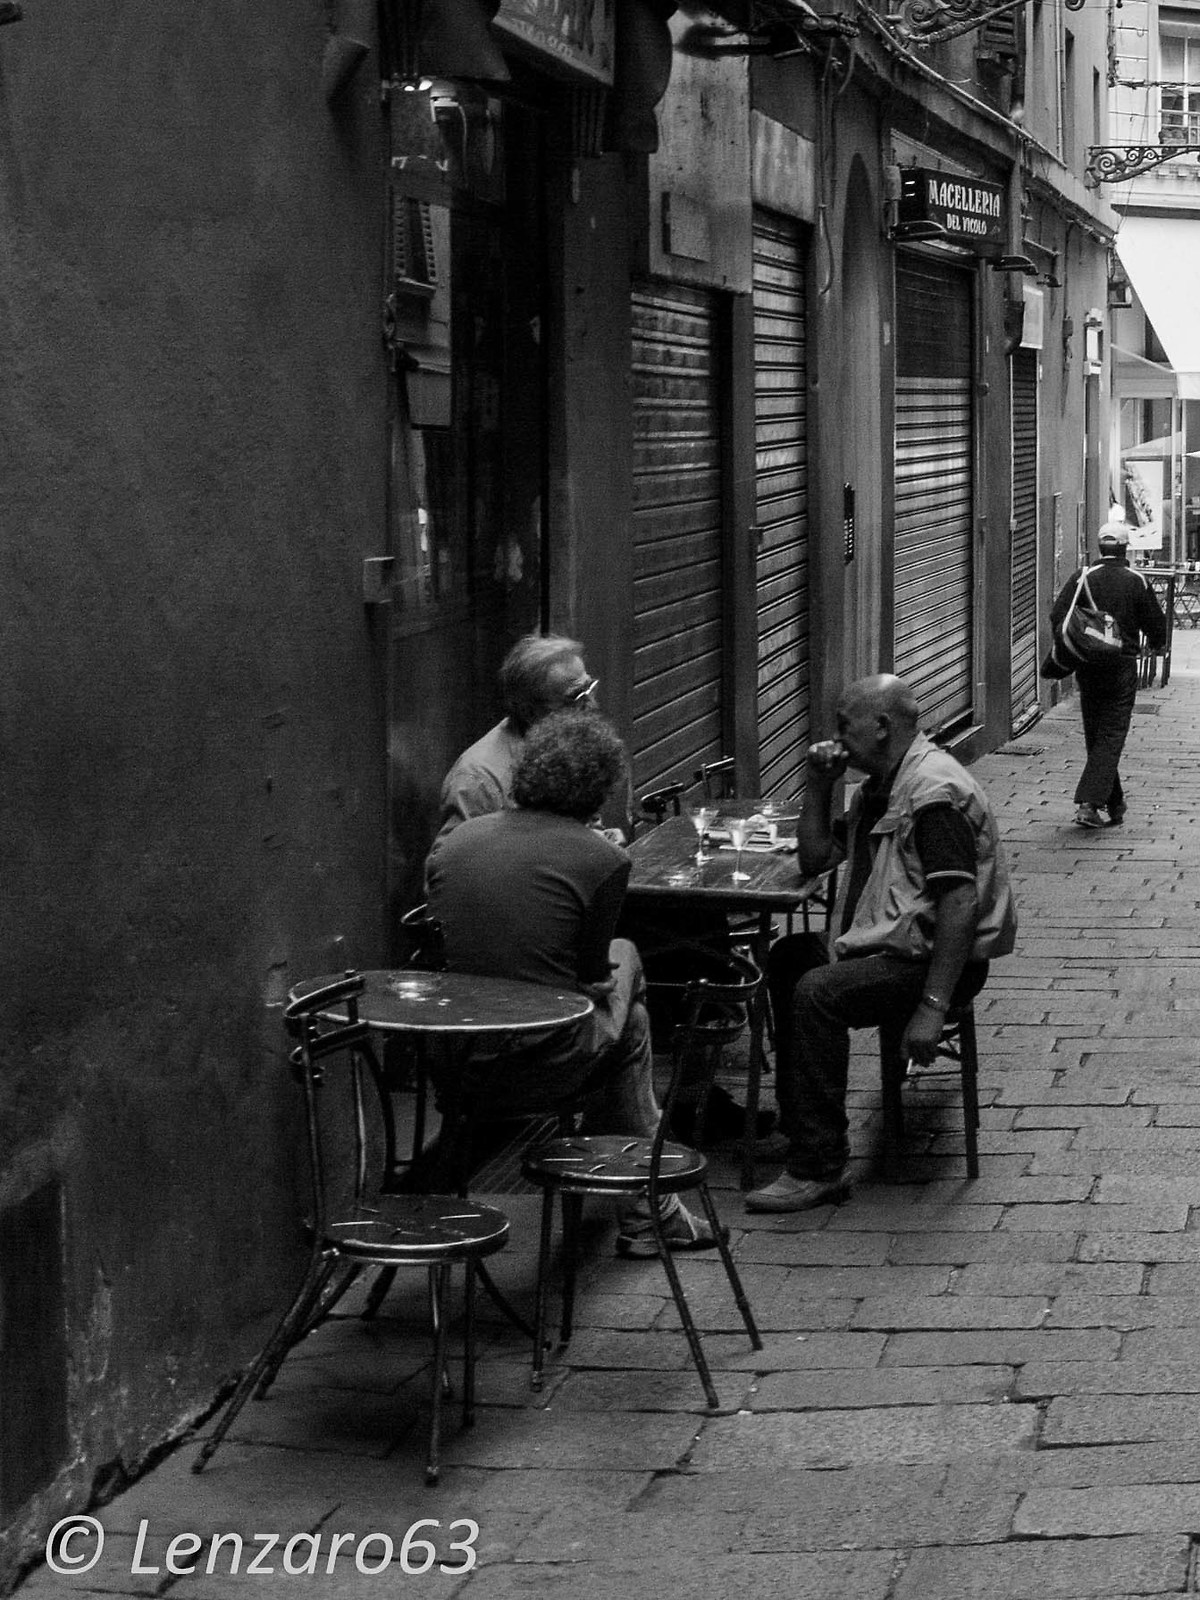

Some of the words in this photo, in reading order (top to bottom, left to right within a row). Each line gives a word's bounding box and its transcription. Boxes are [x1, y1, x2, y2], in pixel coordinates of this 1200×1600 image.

[928, 179, 1000, 218] MACELLERIA
[946, 213, 961, 231] DEL
[962, 216, 987, 235] VICOLO
